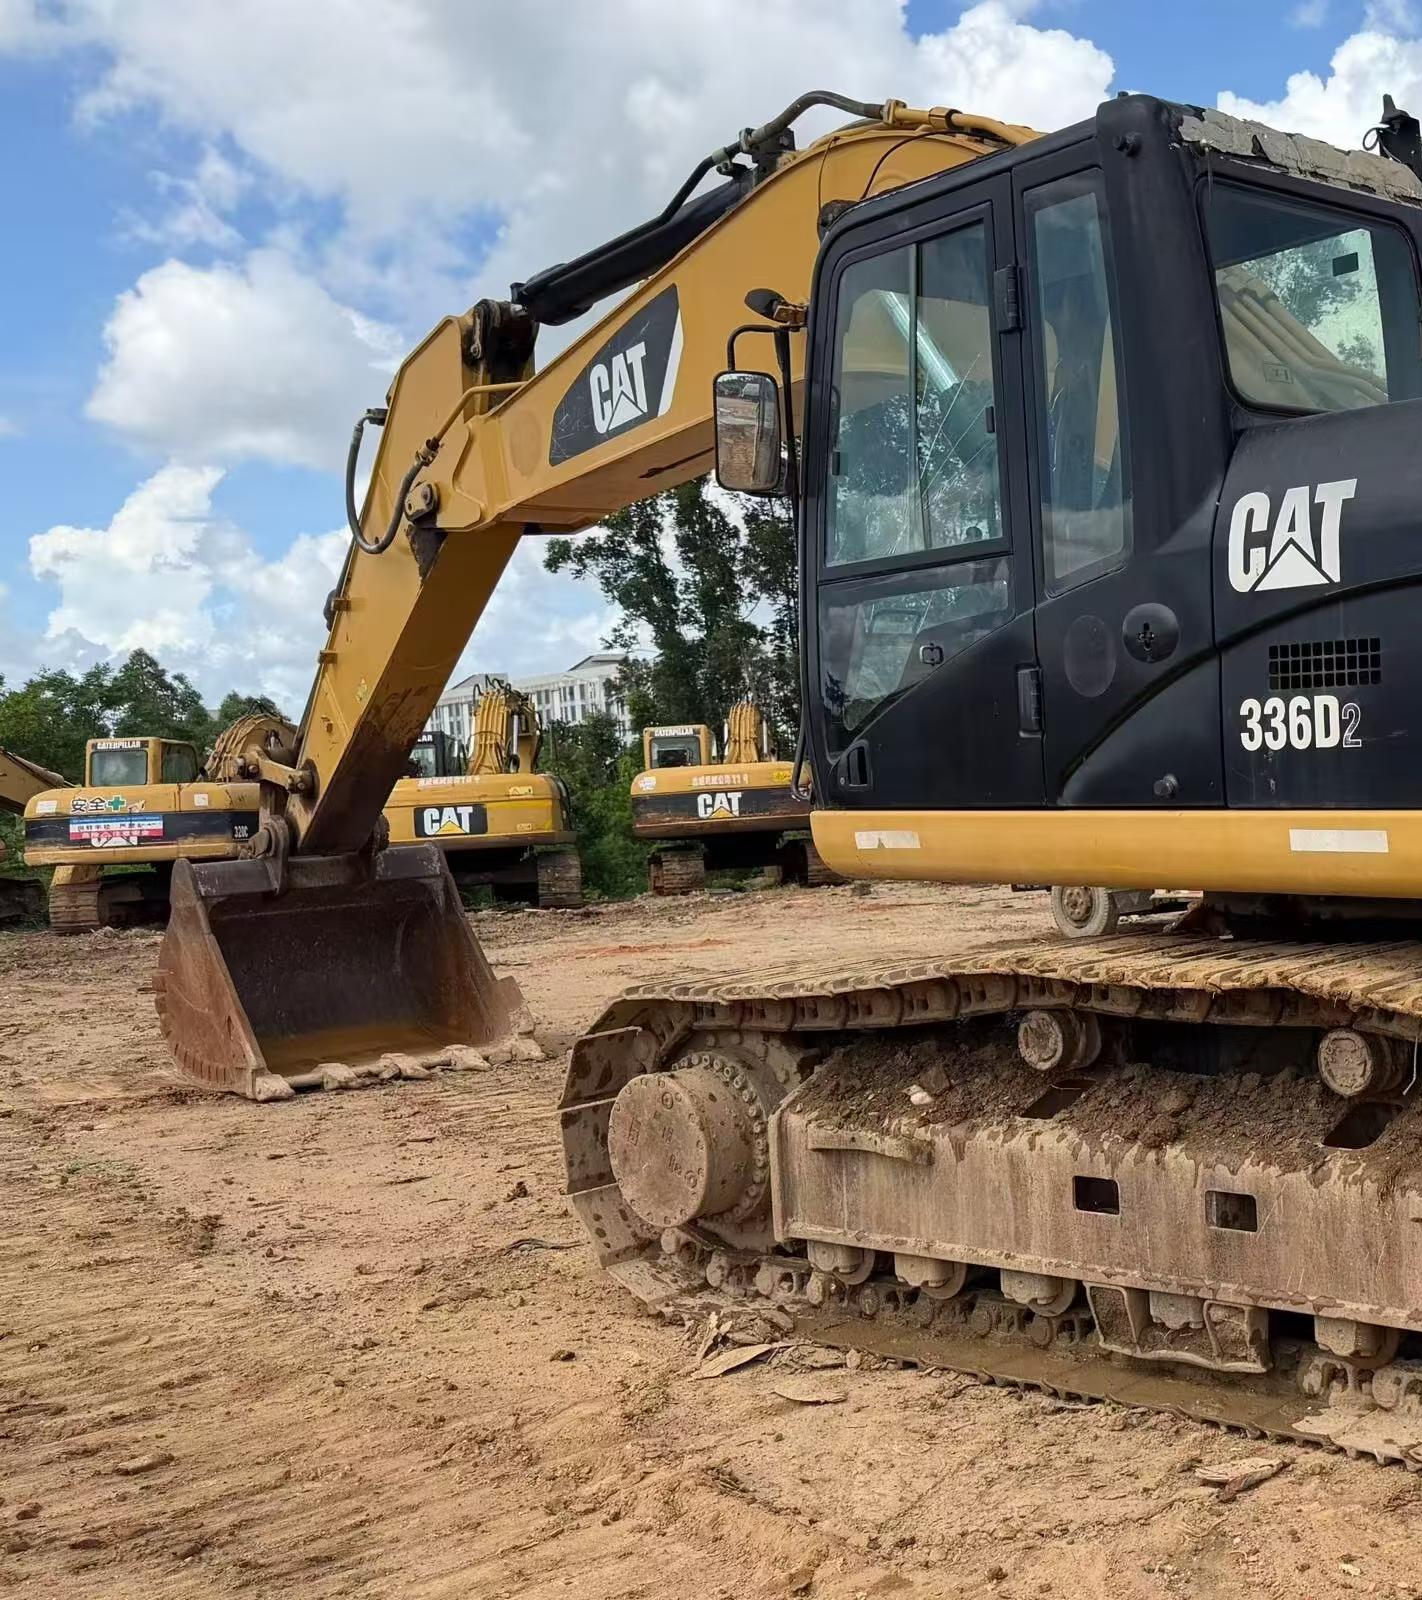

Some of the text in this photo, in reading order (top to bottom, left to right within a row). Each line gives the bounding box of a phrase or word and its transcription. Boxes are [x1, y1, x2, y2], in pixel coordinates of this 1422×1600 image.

[590, 341, 648, 434] CAT
[1228, 478, 1358, 593] CAT
[654, 728, 694, 737] CATERPILLAR
[1239, 695, 1362, 753] 336D2
[97, 740, 141, 749] CATERPILLAR
[70, 797, 106, 814] 安全
[697, 791, 742, 819] CAT
[423, 806, 473, 836] CAT
